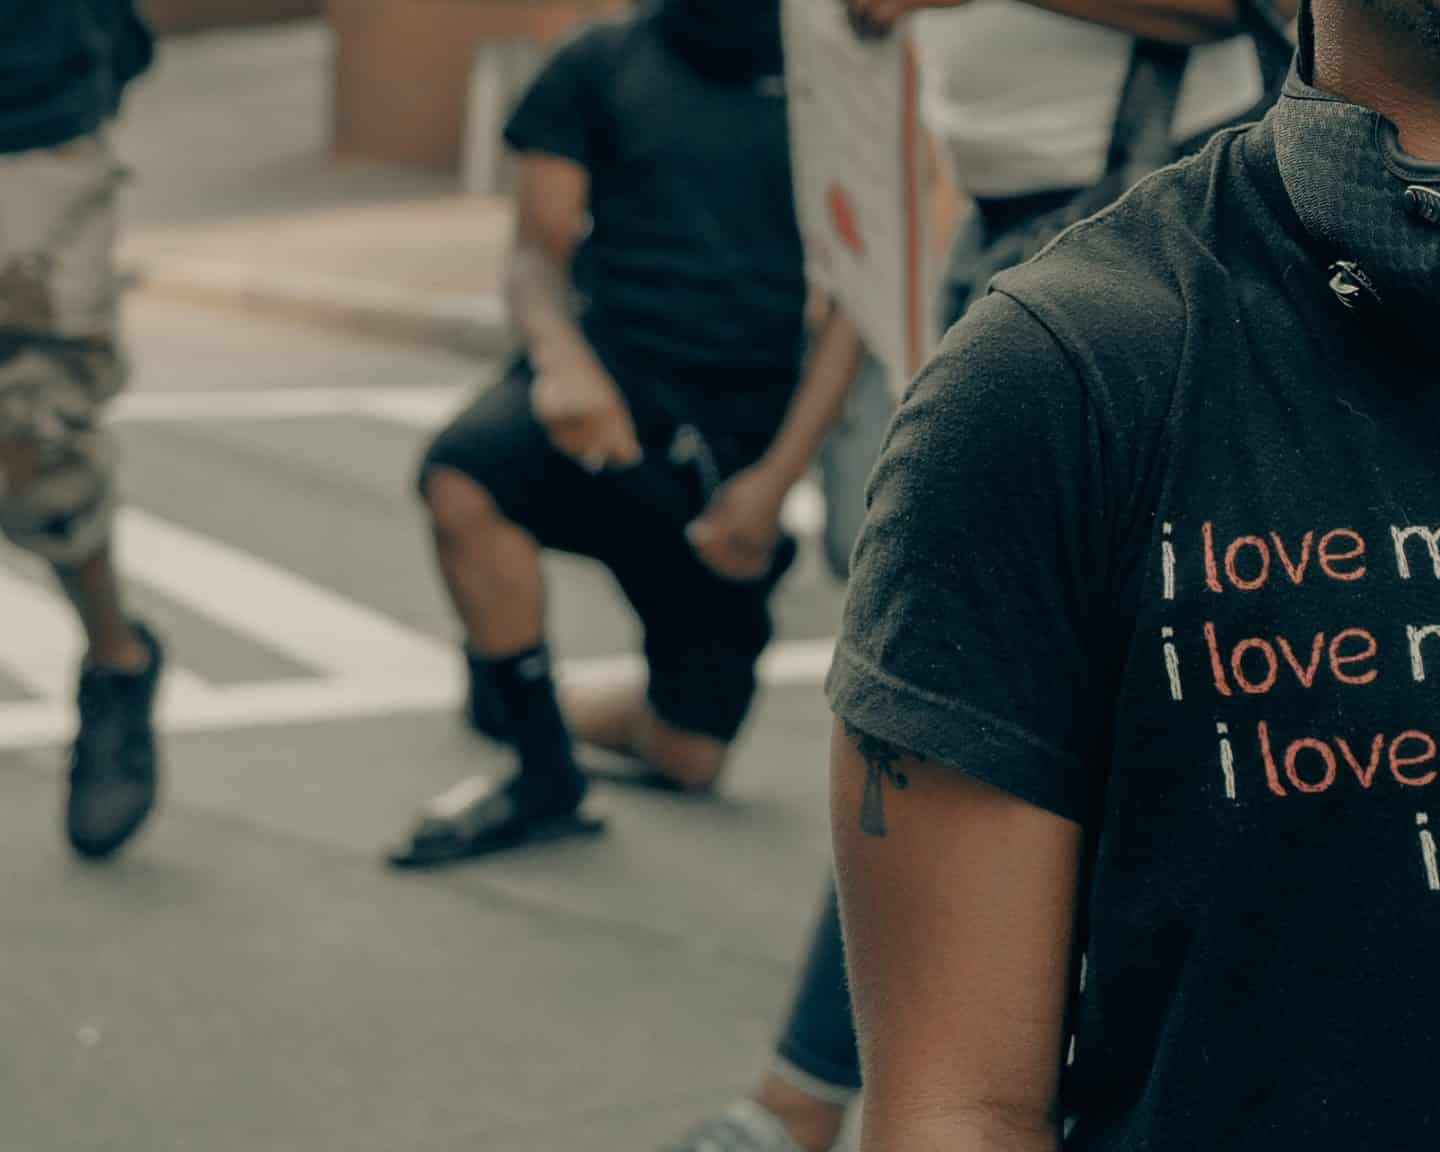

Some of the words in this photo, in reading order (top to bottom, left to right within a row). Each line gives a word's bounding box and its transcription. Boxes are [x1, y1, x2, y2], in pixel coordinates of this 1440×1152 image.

[1162, 522, 1176, 600] i
[1201, 521, 1367, 593] love
[1161, 626, 1183, 700] i
[1204, 622, 1378, 696] love
[1216, 722, 1236, 800] i
[1257, 721, 1438, 796] love
[1415, 812, 1440, 890] i
